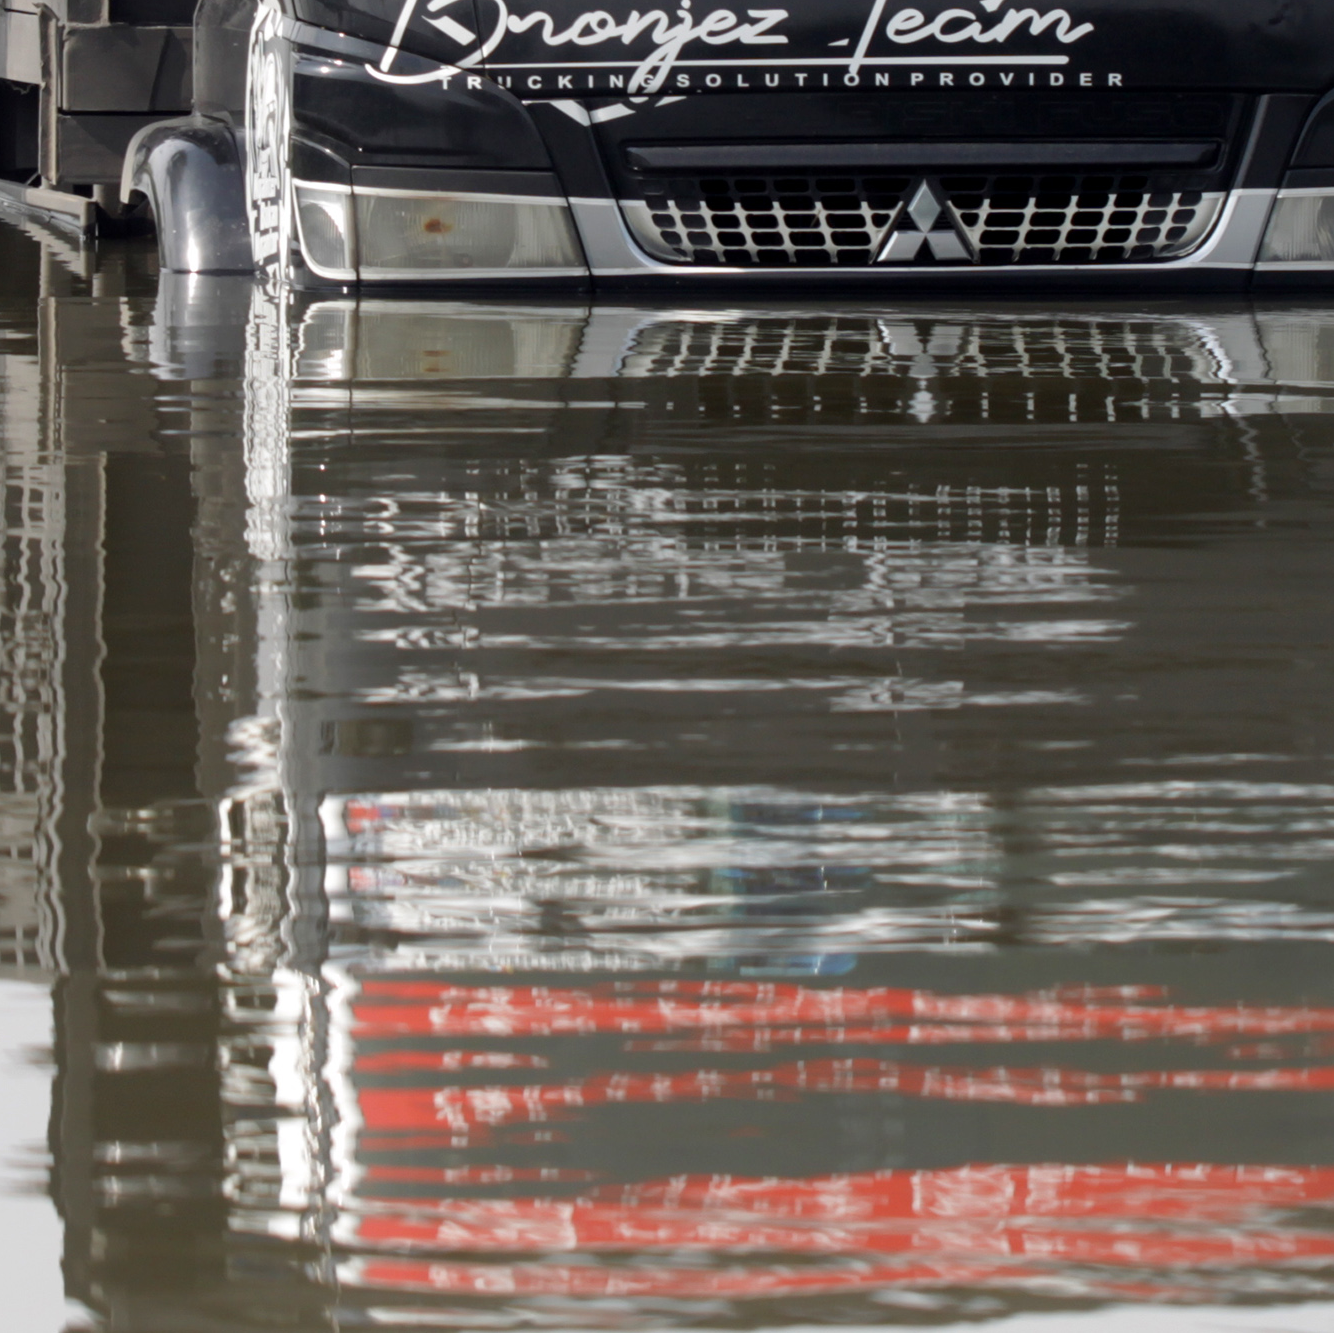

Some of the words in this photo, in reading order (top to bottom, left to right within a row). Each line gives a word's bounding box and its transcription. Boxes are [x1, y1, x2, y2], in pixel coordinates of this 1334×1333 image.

[439, 73, 658, 91] TRUCKING
[677, 72, 889, 88] SOLUTION
[911, 72, 1123, 87] PROVIDER
